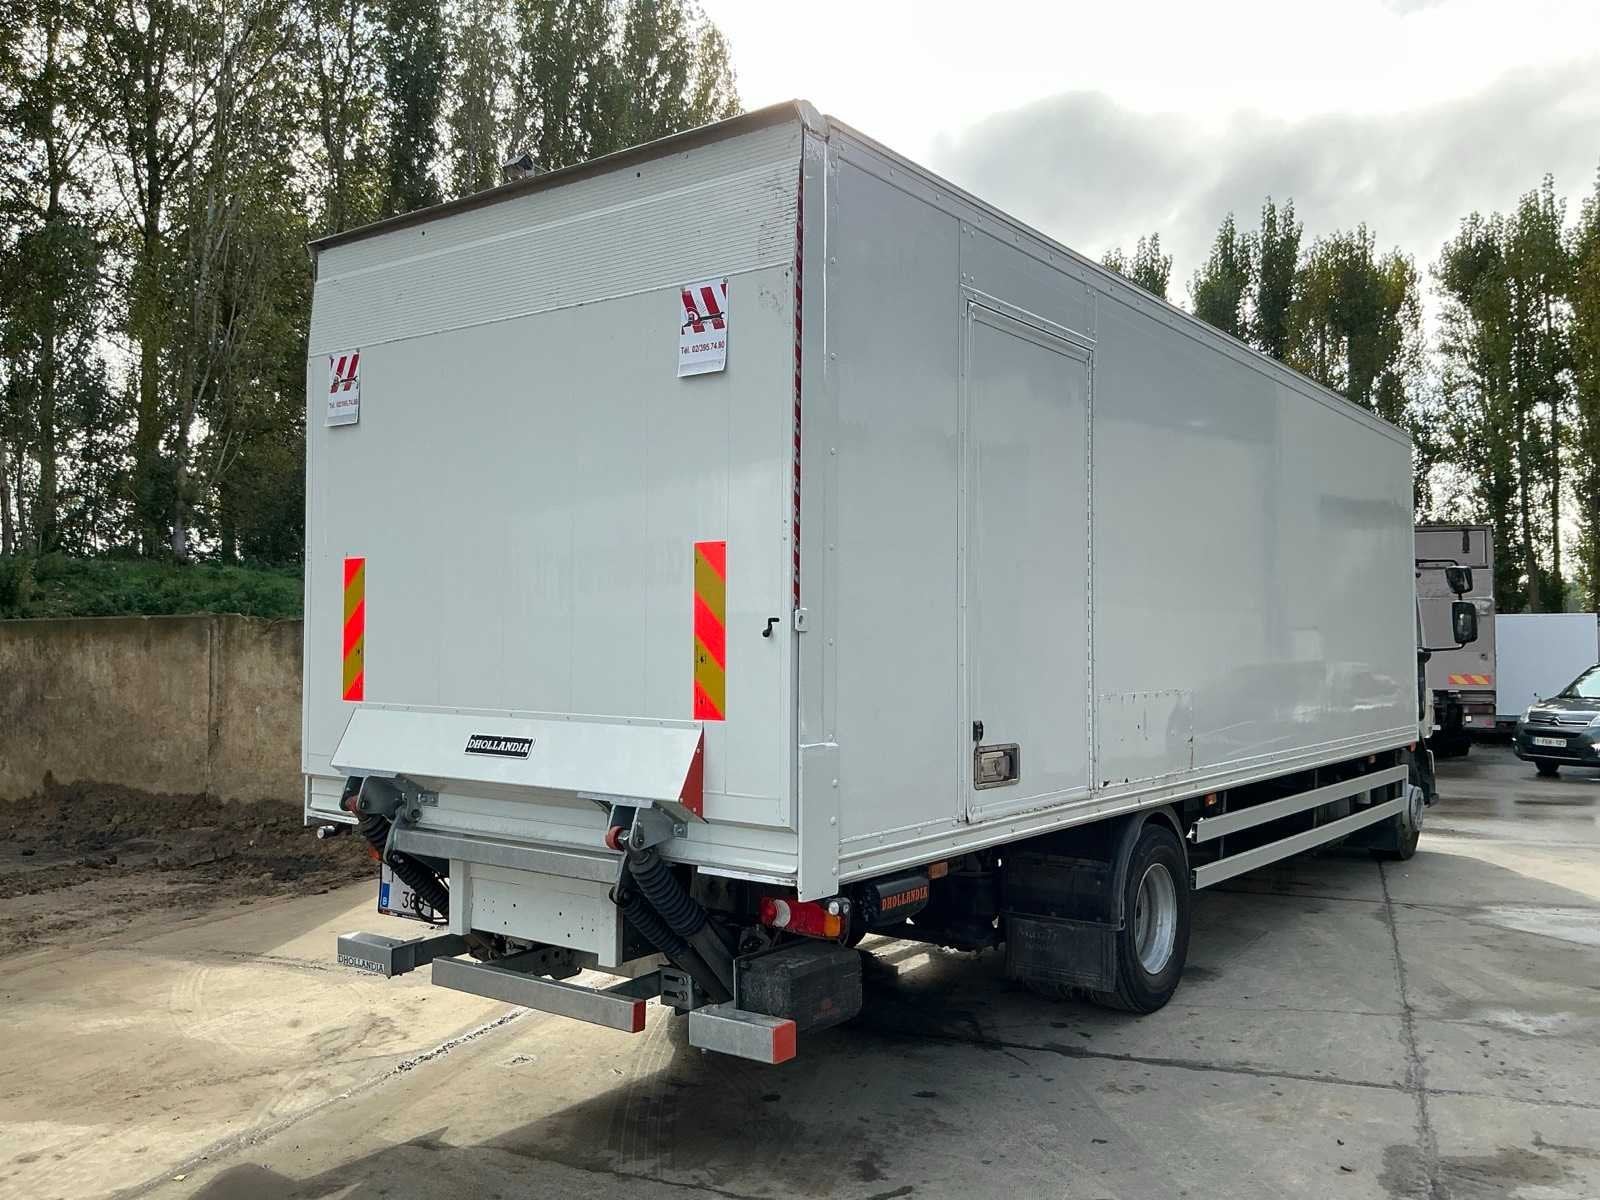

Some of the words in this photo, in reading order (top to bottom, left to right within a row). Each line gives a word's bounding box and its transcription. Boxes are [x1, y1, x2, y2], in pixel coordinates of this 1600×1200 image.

[467, 739, 530, 753] DHOLLANDIA
[881, 885, 928, 911] DHOLLANDIA
[337, 954, 384, 973] DHOLLANDIA
